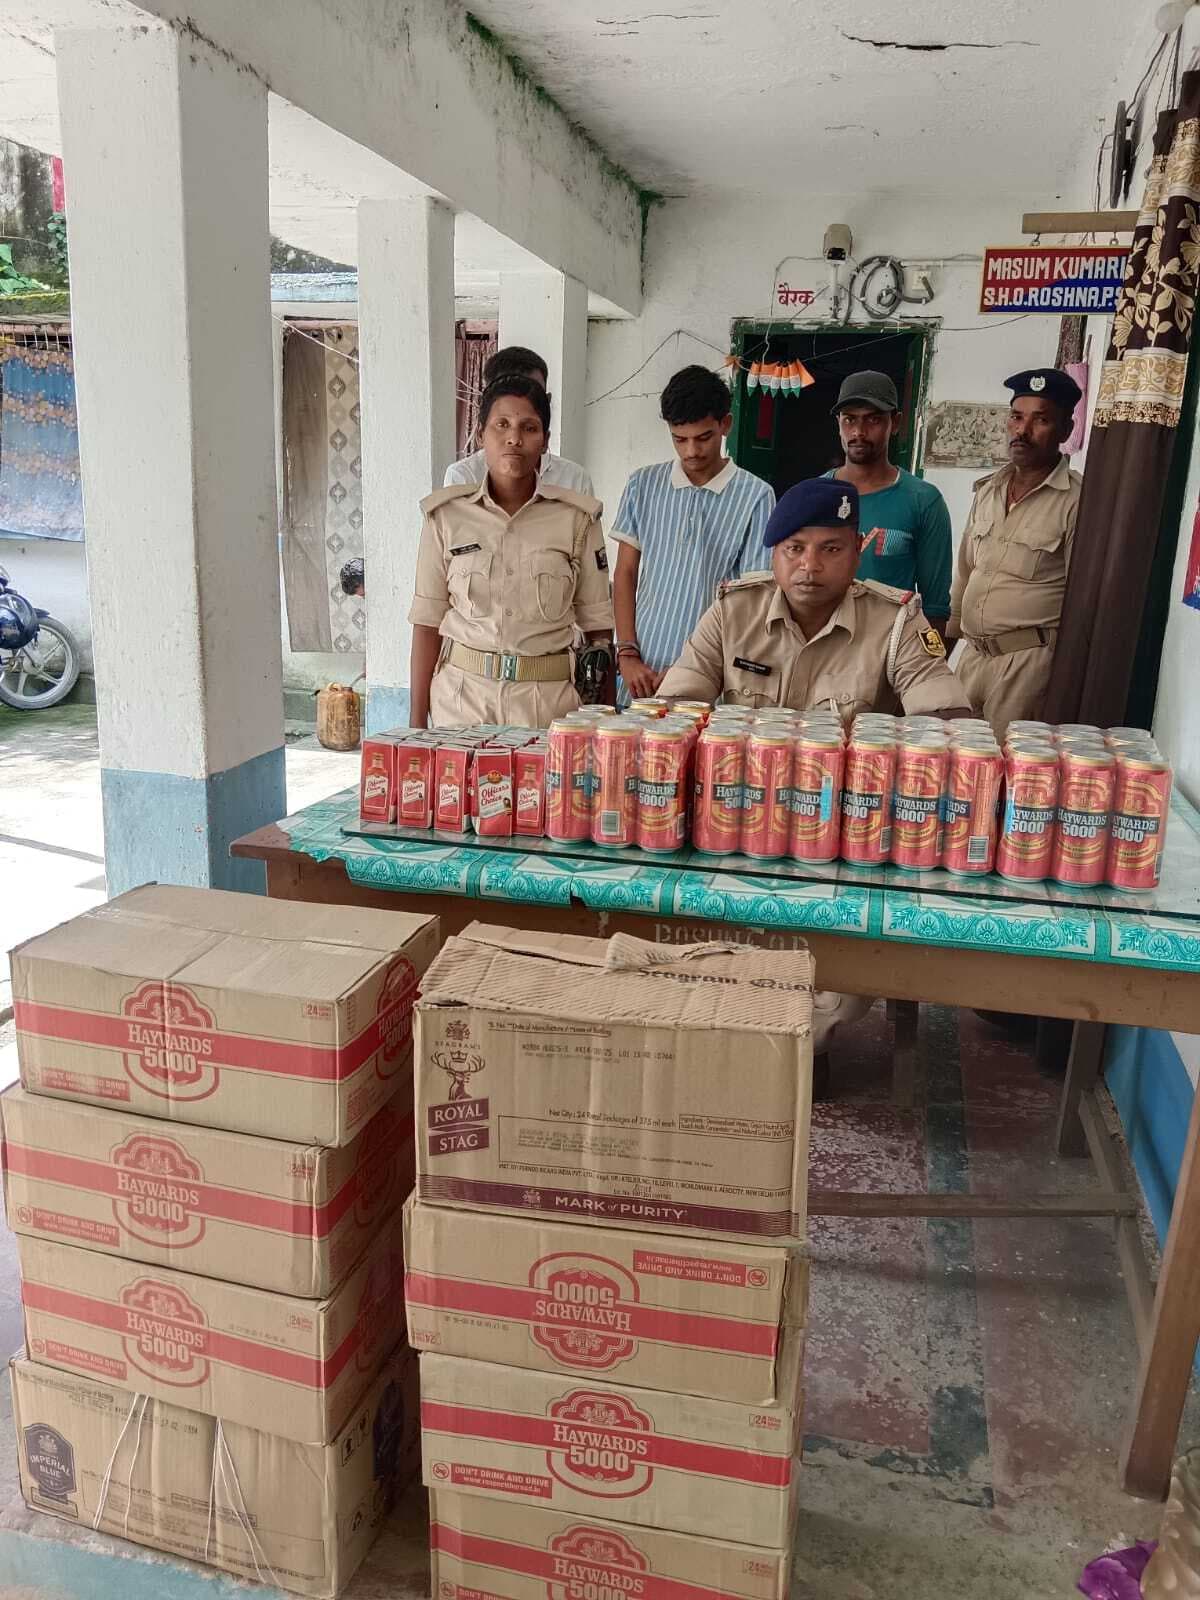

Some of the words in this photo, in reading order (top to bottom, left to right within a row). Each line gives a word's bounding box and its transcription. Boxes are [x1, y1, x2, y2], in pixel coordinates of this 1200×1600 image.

[987, 256, 1049, 281] MASUM
[895, 809, 926, 823] 5000
[1011, 819, 1045, 833] 5000
[1058, 808, 1107, 826] HAYWARDS
[1062, 823, 1097, 838] 5000
[1111, 826, 1144, 843] 5000
[128, 1023, 212, 1055] HAYWARDS
[144, 1046, 196, 1074] 5000
[434, 1103, 484, 1124] ROYAL
[439, 1133, 479, 1151] STAG
[117, 1171, 200, 1206] HAYWARDS
[132, 1194, 184, 1223] 5000
[555, 1196, 605, 1211] MARK
[620, 1203, 685, 1219] PURITY
[636, 1262, 663, 1274] DRIVE
[664, 1265, 684, 1276] AND
[685, 1268, 712, 1281] DRINK
[553, 1281, 615, 1308] 5000
[535, 1300, 632, 1332] HAYWARDS
[126, 1311, 204, 1348] HAYWARDS
[140, 1333, 190, 1363] 5000
[553, 1424, 648, 1456] HAYWARDS
[30, 1454, 71, 1477] IMPERIAL
[570, 1444, 630, 1472] 5000
[39, 1464, 61, 1478] BLUE
[455, 1465, 478, 1476] DON'T
[481, 1469, 505, 1480] DRINK
[507, 1473, 524, 1484] AND
[525, 1477, 551, 1488] DRIVE
[553, 1558, 645, 1593] HAYWARDS
